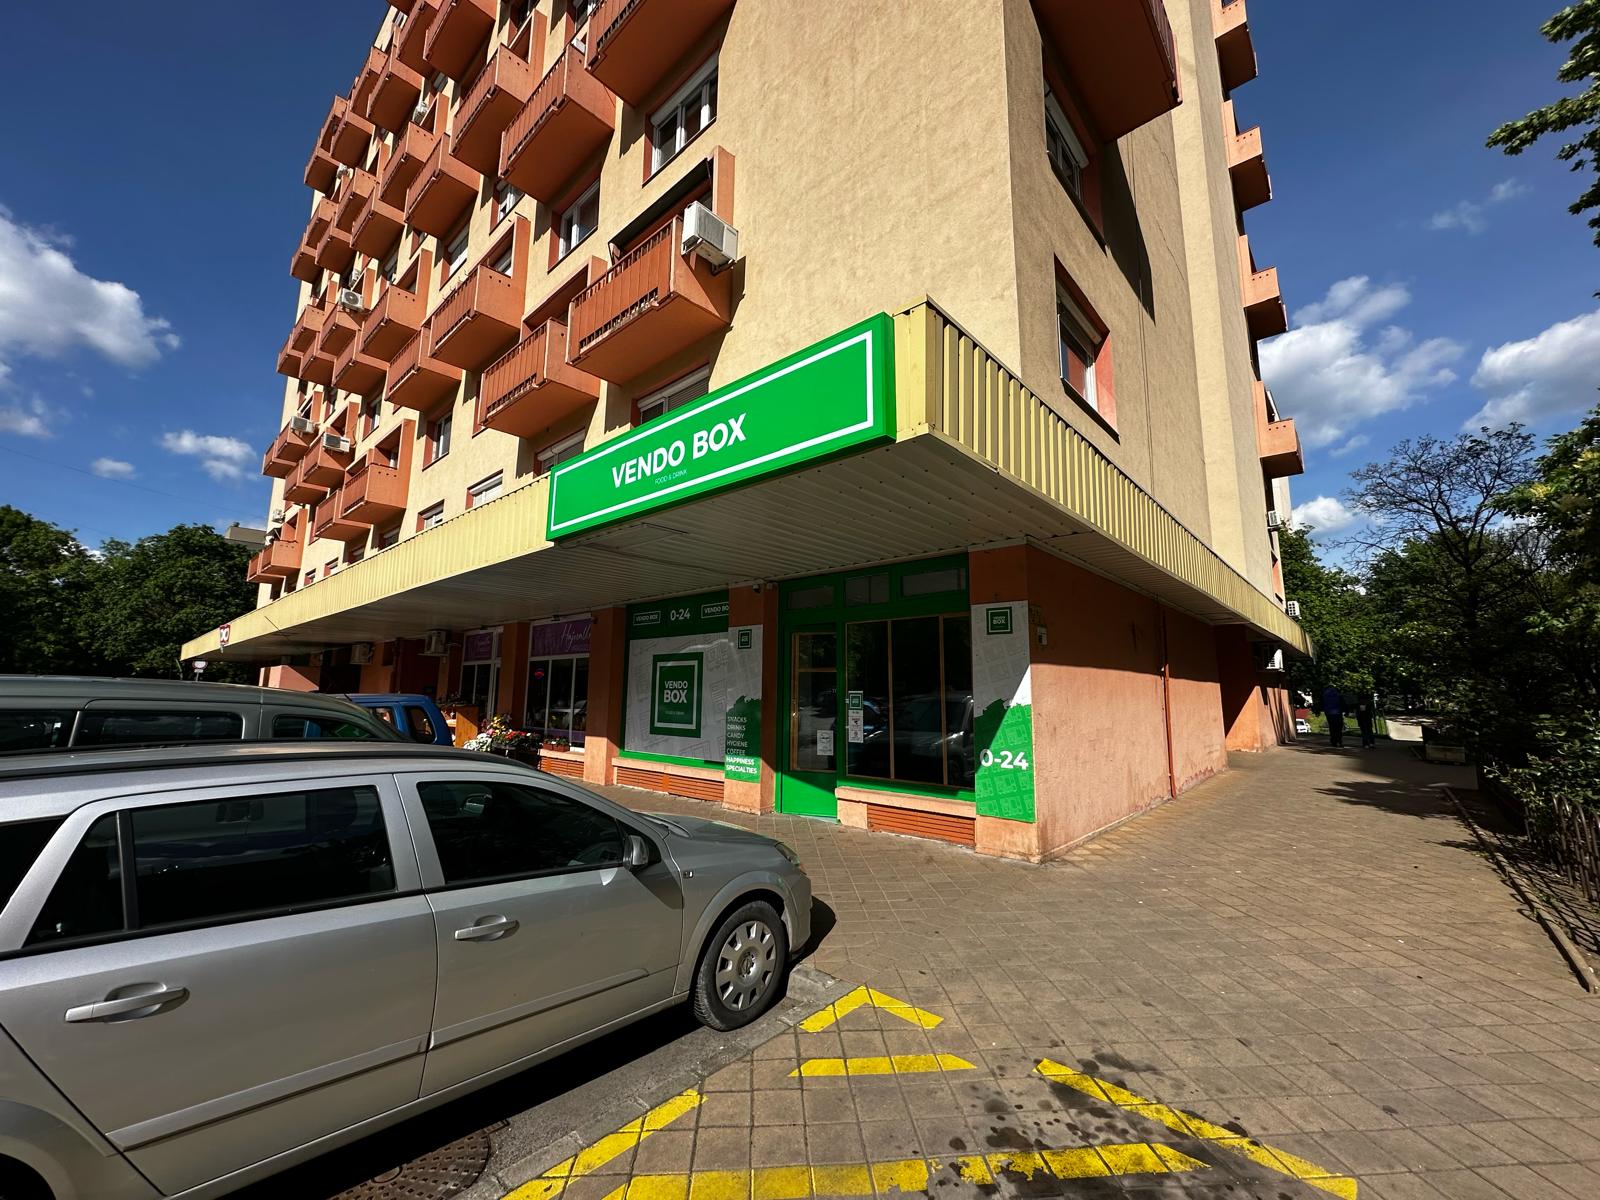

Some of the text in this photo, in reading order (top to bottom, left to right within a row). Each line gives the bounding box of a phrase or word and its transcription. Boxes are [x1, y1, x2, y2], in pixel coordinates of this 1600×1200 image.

[612, 413, 747, 488] VENDO BOX
[654, 475, 668, 485] FOOD
[670, 608, 690, 621] 0-24
[704, 606, 720, 614] VENDO
[664, 680, 688, 689] VENDO
[663, 690, 687, 704] BOX
[727, 747, 746, 756] COFFEE
[726, 755, 754, 766] HAPPINESS
[980, 748, 1029, 770] 0-24
[726, 764, 757, 774] SPECIALTIES
